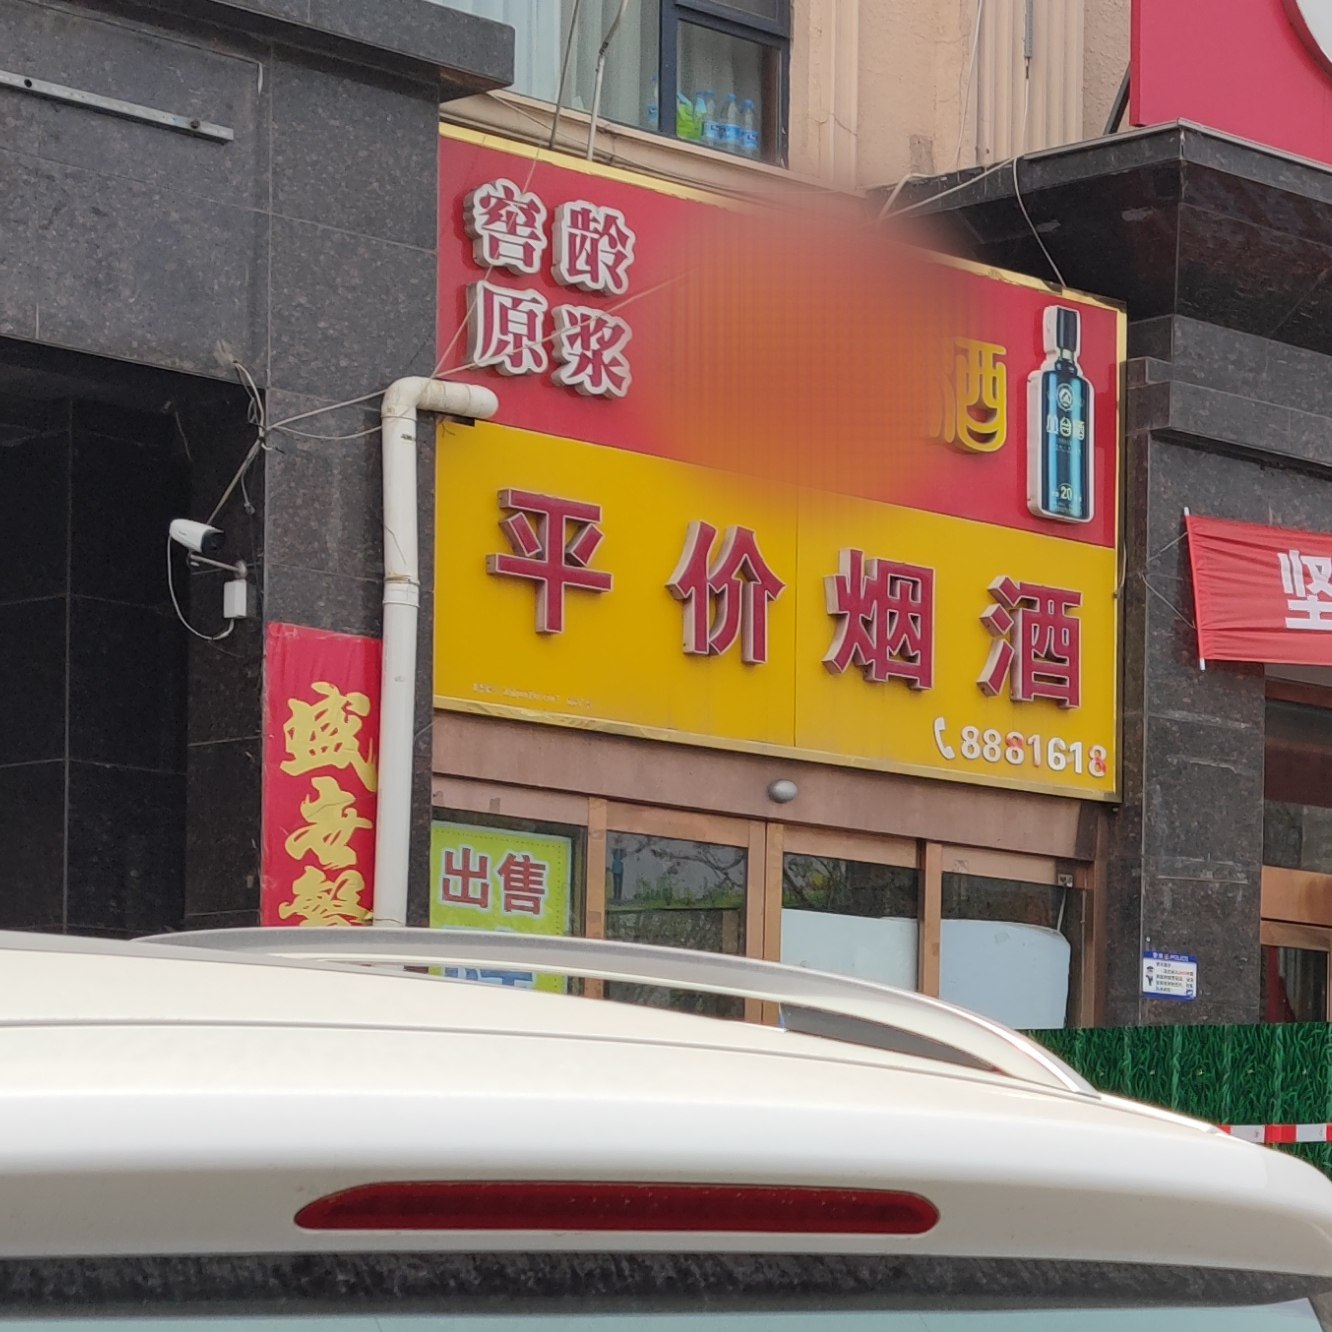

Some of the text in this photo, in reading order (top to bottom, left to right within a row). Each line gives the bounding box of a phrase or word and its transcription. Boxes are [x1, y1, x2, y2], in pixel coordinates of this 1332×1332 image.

[470, 178, 636, 295] 窖龄
[466, 280, 634, 398] 原浆
[486, 488, 1082, 710] 平价烟酒
[961, 726, 1107, 777] 8881618
[441, 847, 547, 915] 出售
